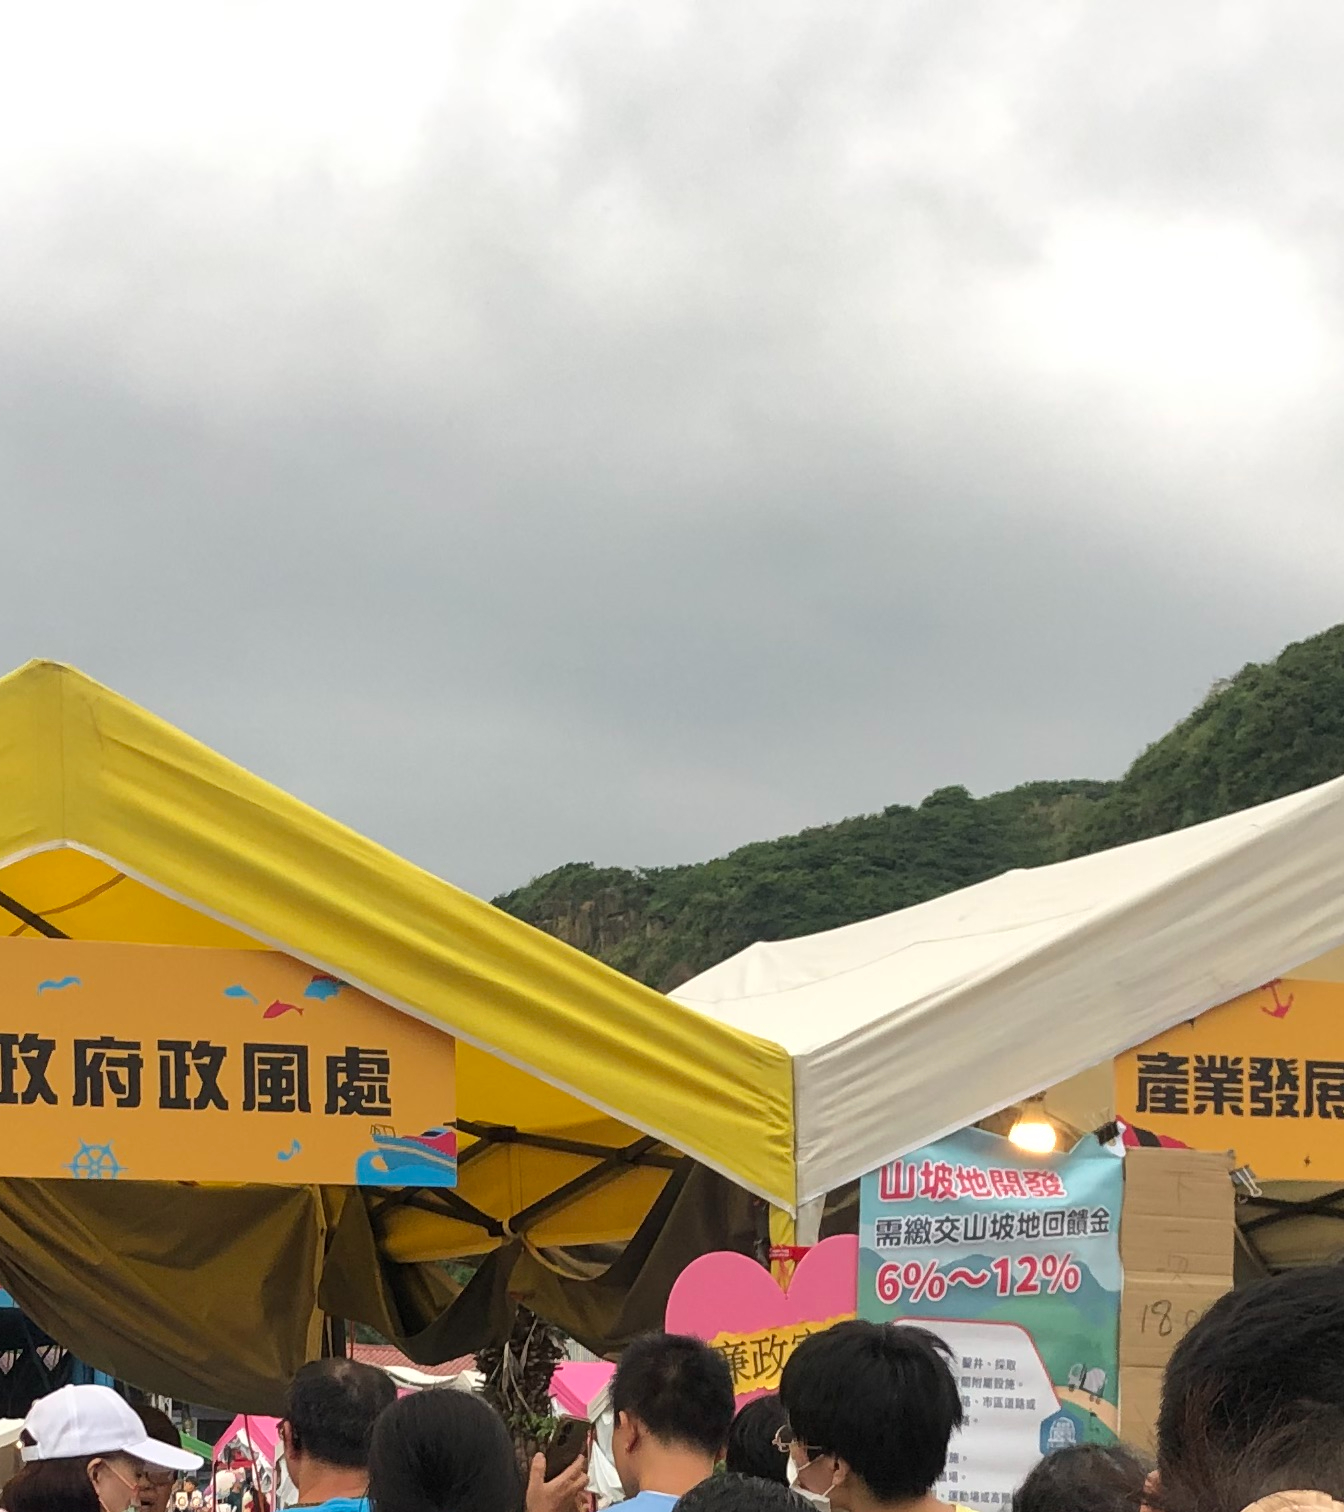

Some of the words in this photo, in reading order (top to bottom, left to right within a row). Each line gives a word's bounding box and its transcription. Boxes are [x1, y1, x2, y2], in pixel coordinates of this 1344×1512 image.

[878, 1161, 1067, 1203] 山坡地開發
[875, 1206, 1111, 1248] 需繳交山坡地回饋金
[714, 1328, 811, 1385] 廉政
